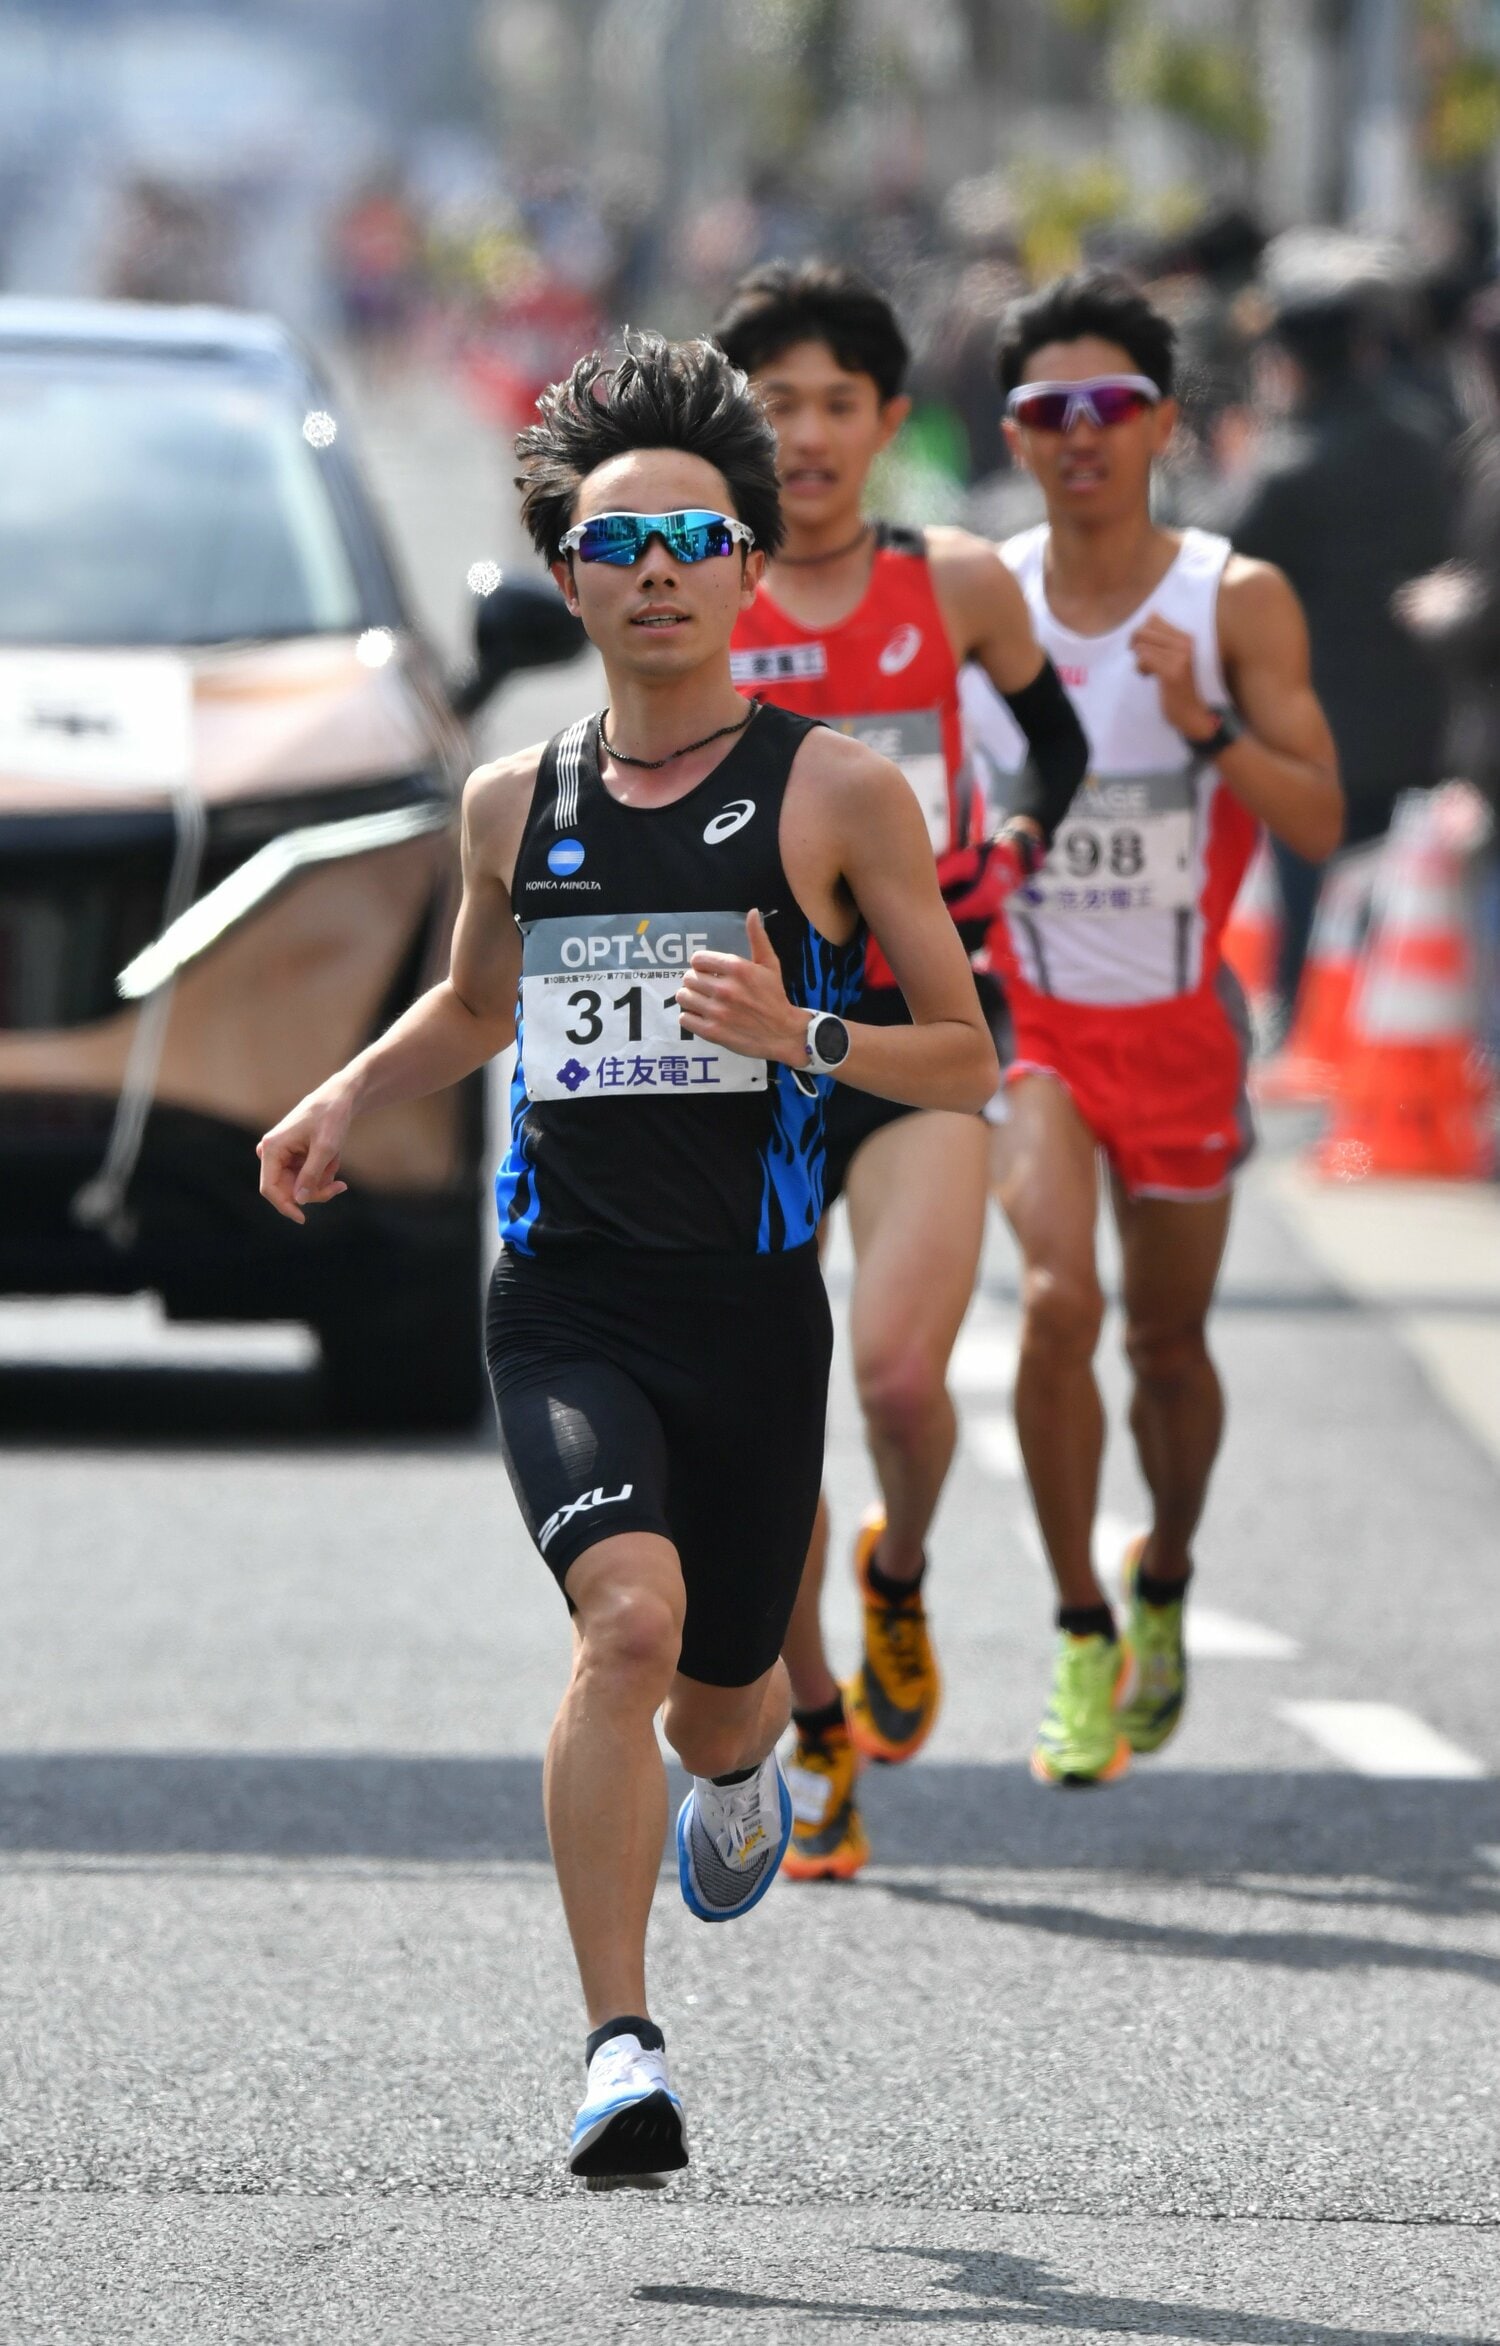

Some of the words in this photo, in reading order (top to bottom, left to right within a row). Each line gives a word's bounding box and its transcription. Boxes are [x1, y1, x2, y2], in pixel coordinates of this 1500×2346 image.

[1047, 827, 1145, 878] 98
[525, 880, 558, 891] KONICA
[560, 880, 602, 891] MINOLTA
[560, 921, 708, 968] OPTAGE
[596, 1055, 721, 1089] 住友電工
[537, 1484, 634, 1554] 2XU
